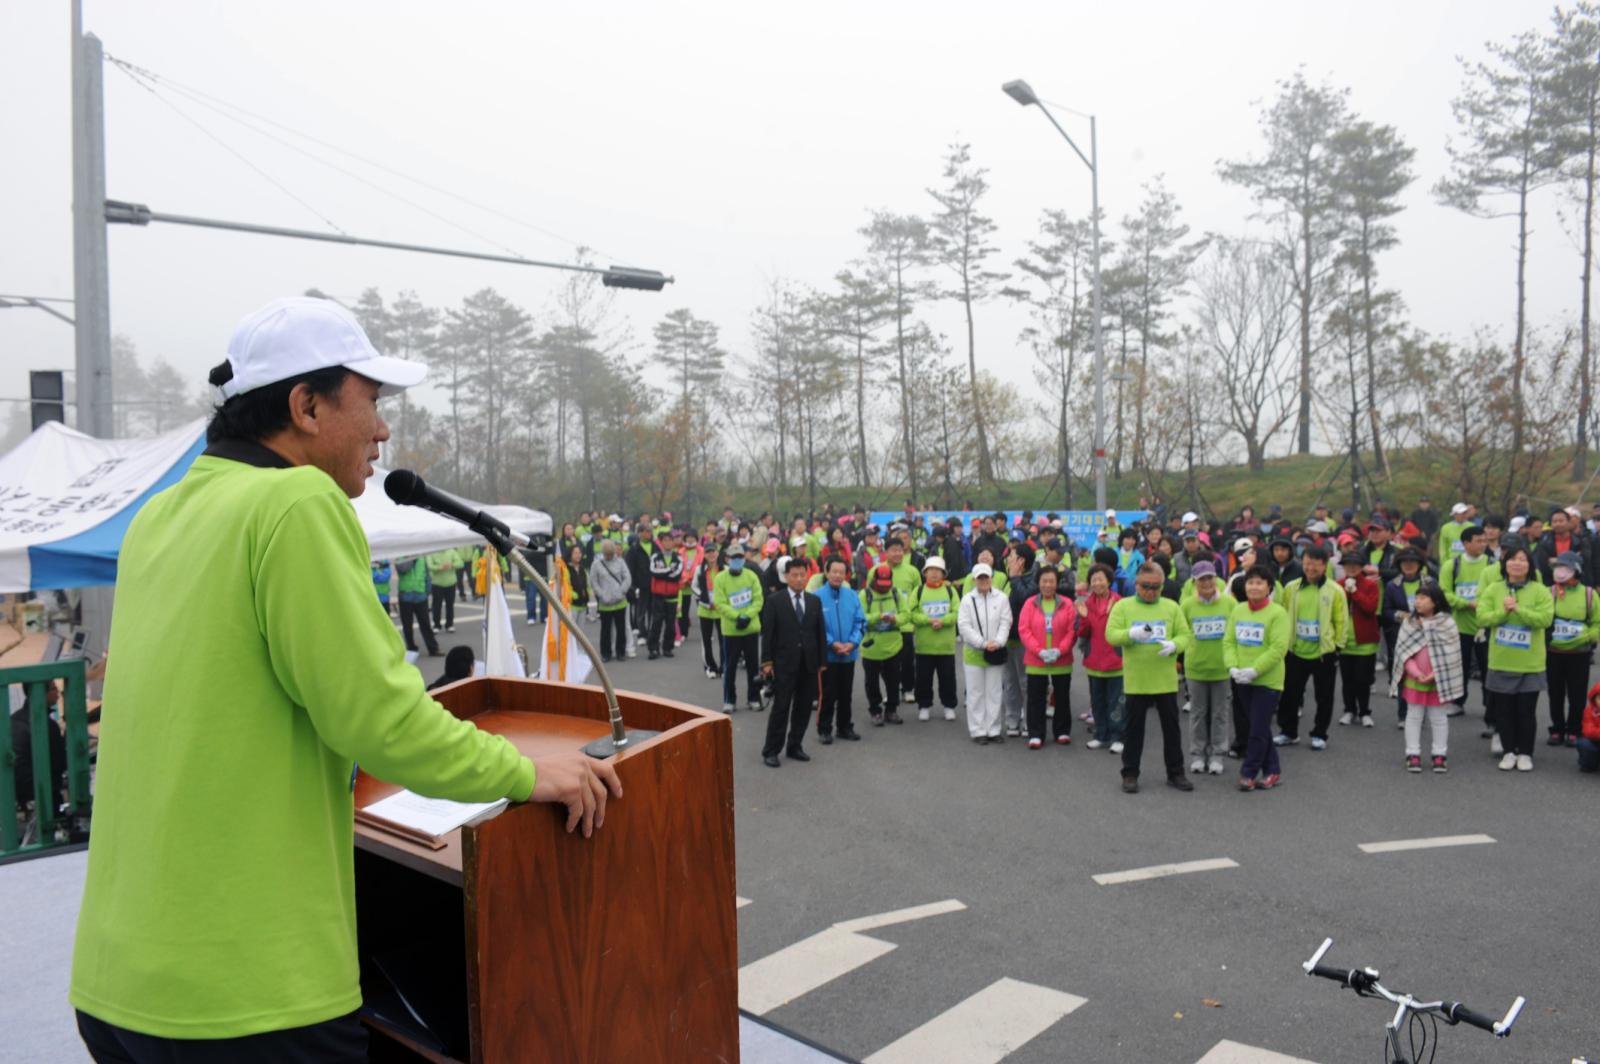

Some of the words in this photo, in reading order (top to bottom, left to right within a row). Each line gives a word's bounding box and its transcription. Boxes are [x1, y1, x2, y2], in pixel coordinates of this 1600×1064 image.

[1196, 623, 1224, 633] 752
[1238, 629, 1260, 639] 754
[1499, 630, 1526, 642] 670
